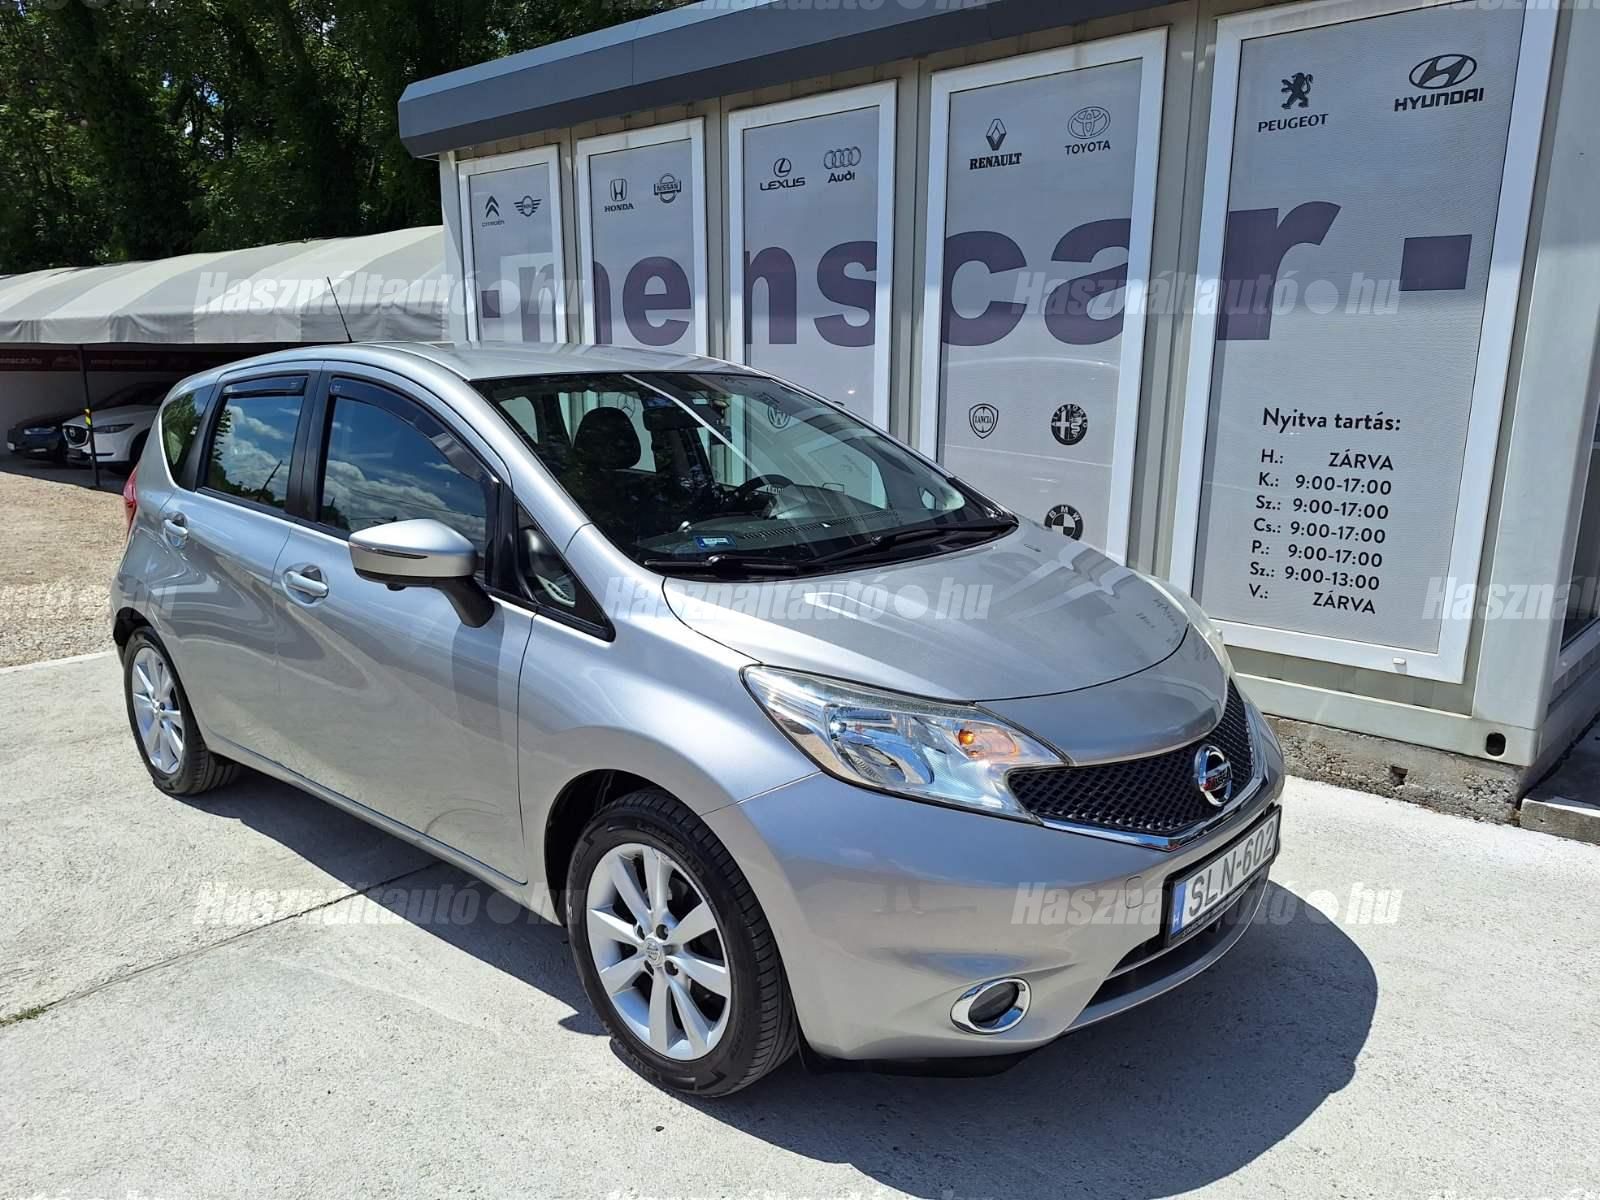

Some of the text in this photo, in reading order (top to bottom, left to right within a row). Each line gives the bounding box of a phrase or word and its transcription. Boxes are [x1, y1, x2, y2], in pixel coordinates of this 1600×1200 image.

[1394, 88, 1484, 112] HYUNDAI
[1258, 113, 1329, 133] PEUGEOT
[1064, 140, 1111, 155] TOYOTA
[969, 152, 1022, 170] RENAULT
[760, 177, 806, 191] LEXUS
[827, 170, 856, 184] Audi
[604, 202, 635, 213] HONDA
[1262, 407, 1401, 433] Nyitva tartás:
[1260, 449, 1395, 471] H.: ZÁRVA
[1258, 472, 1392, 496] K.: 9:00-17:00
[1048, 506, 1081, 522] BMW
[1255, 495, 1389, 520] Sz.: 9:00-17:00
[1254, 518, 1386, 544] Cs.: 9:00-17:00
[1251, 540, 1383, 568] P.: 9:00-17:00
[1250, 562, 1380, 591] Sz.: 9:00-13:00
[1249, 583, 1376, 614] V.: ZÁRVA
[1188, 820, 1275, 918] SLN-602
